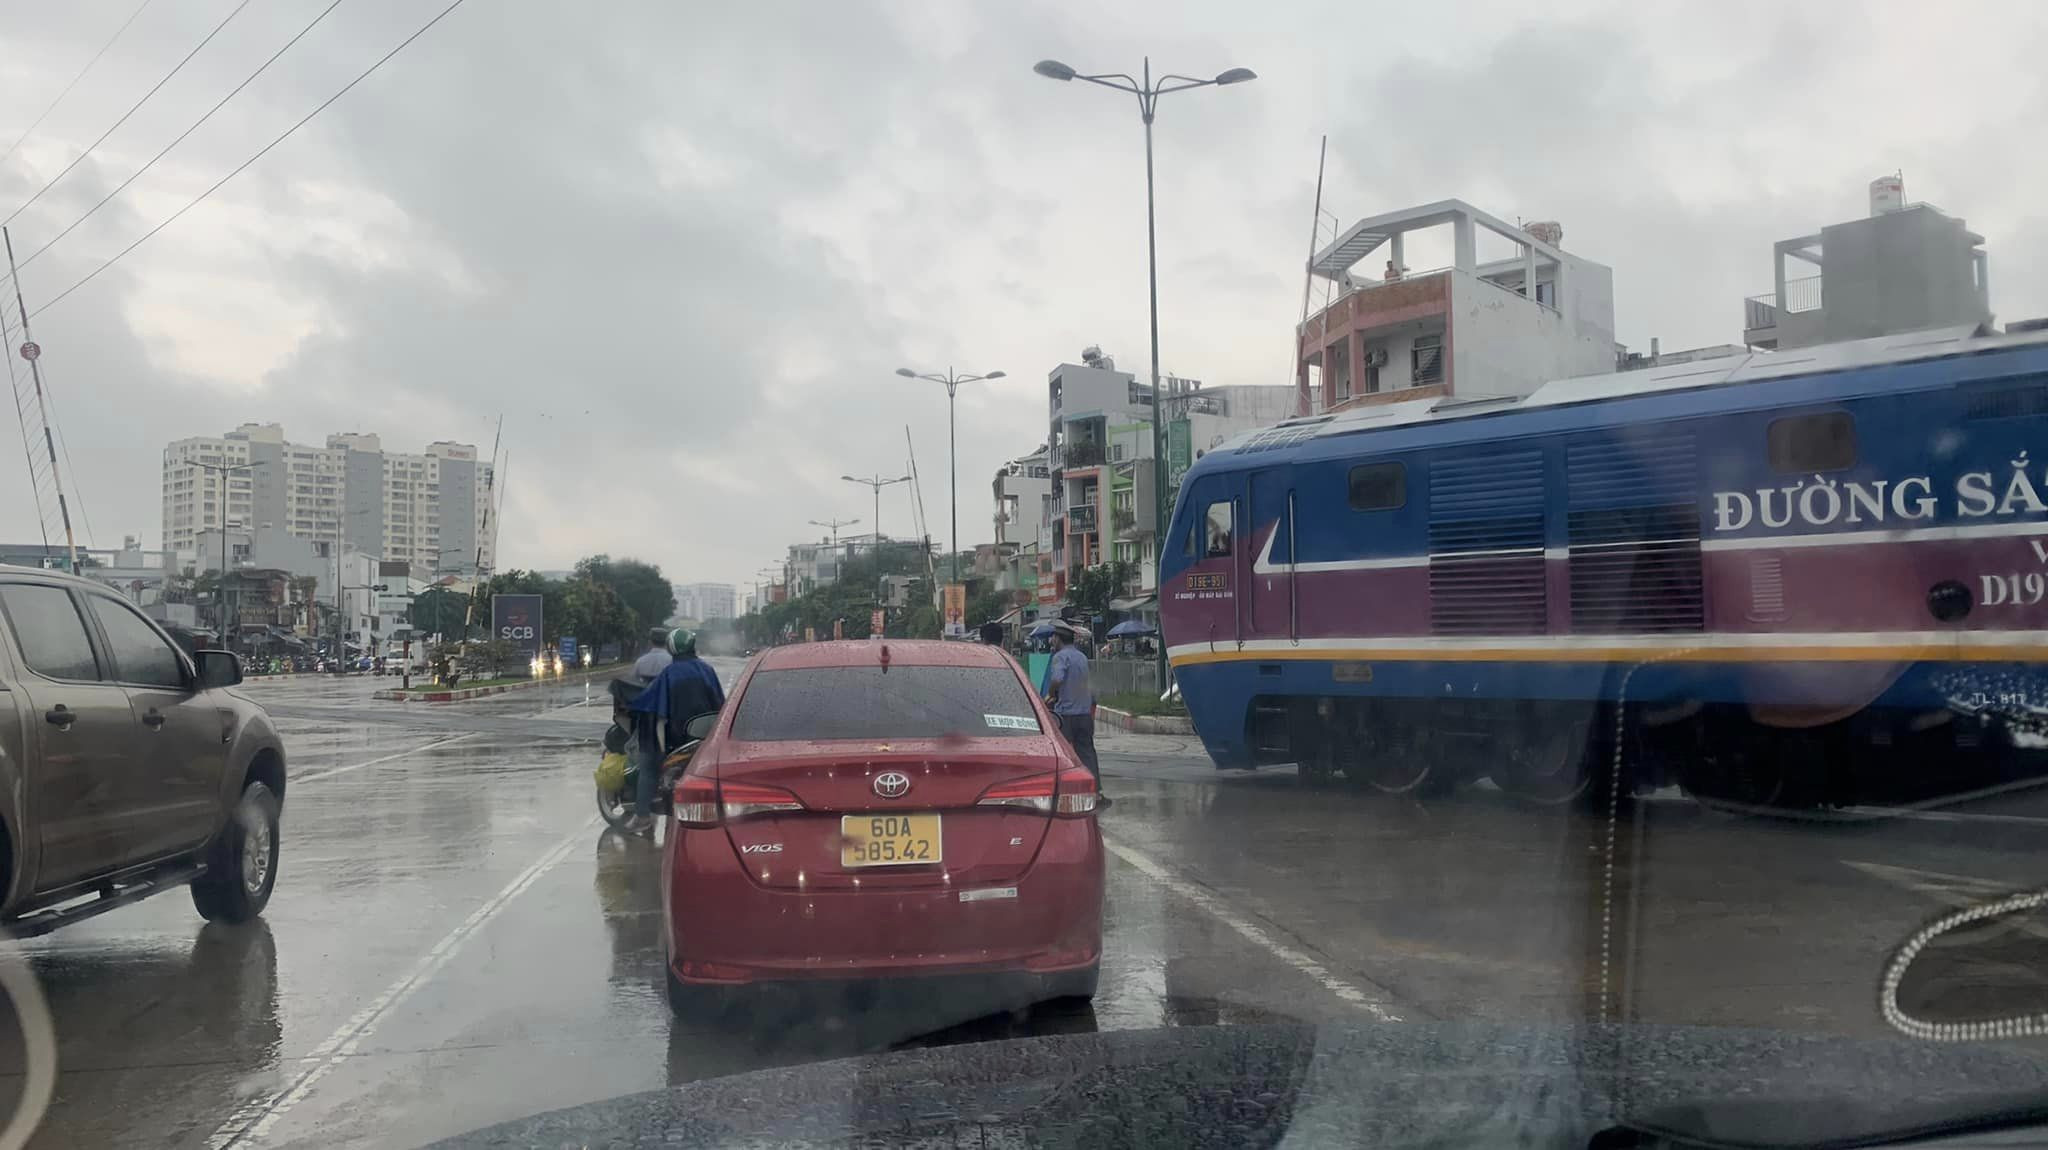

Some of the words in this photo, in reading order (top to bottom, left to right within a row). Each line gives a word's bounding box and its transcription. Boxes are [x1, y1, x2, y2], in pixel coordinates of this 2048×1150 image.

[1713, 473, 1938, 531] ĐƯỜNG
[1957, 450, 2048, 517] SẮ
[1979, 572, 2048, 606] D19
[501, 626, 534, 640] SCB
[871, 817, 912, 838] 60A
[741, 843, 783, 854] VIOS
[853, 840, 930, 862] 585.42
[1010, 837, 1022, 845] E
